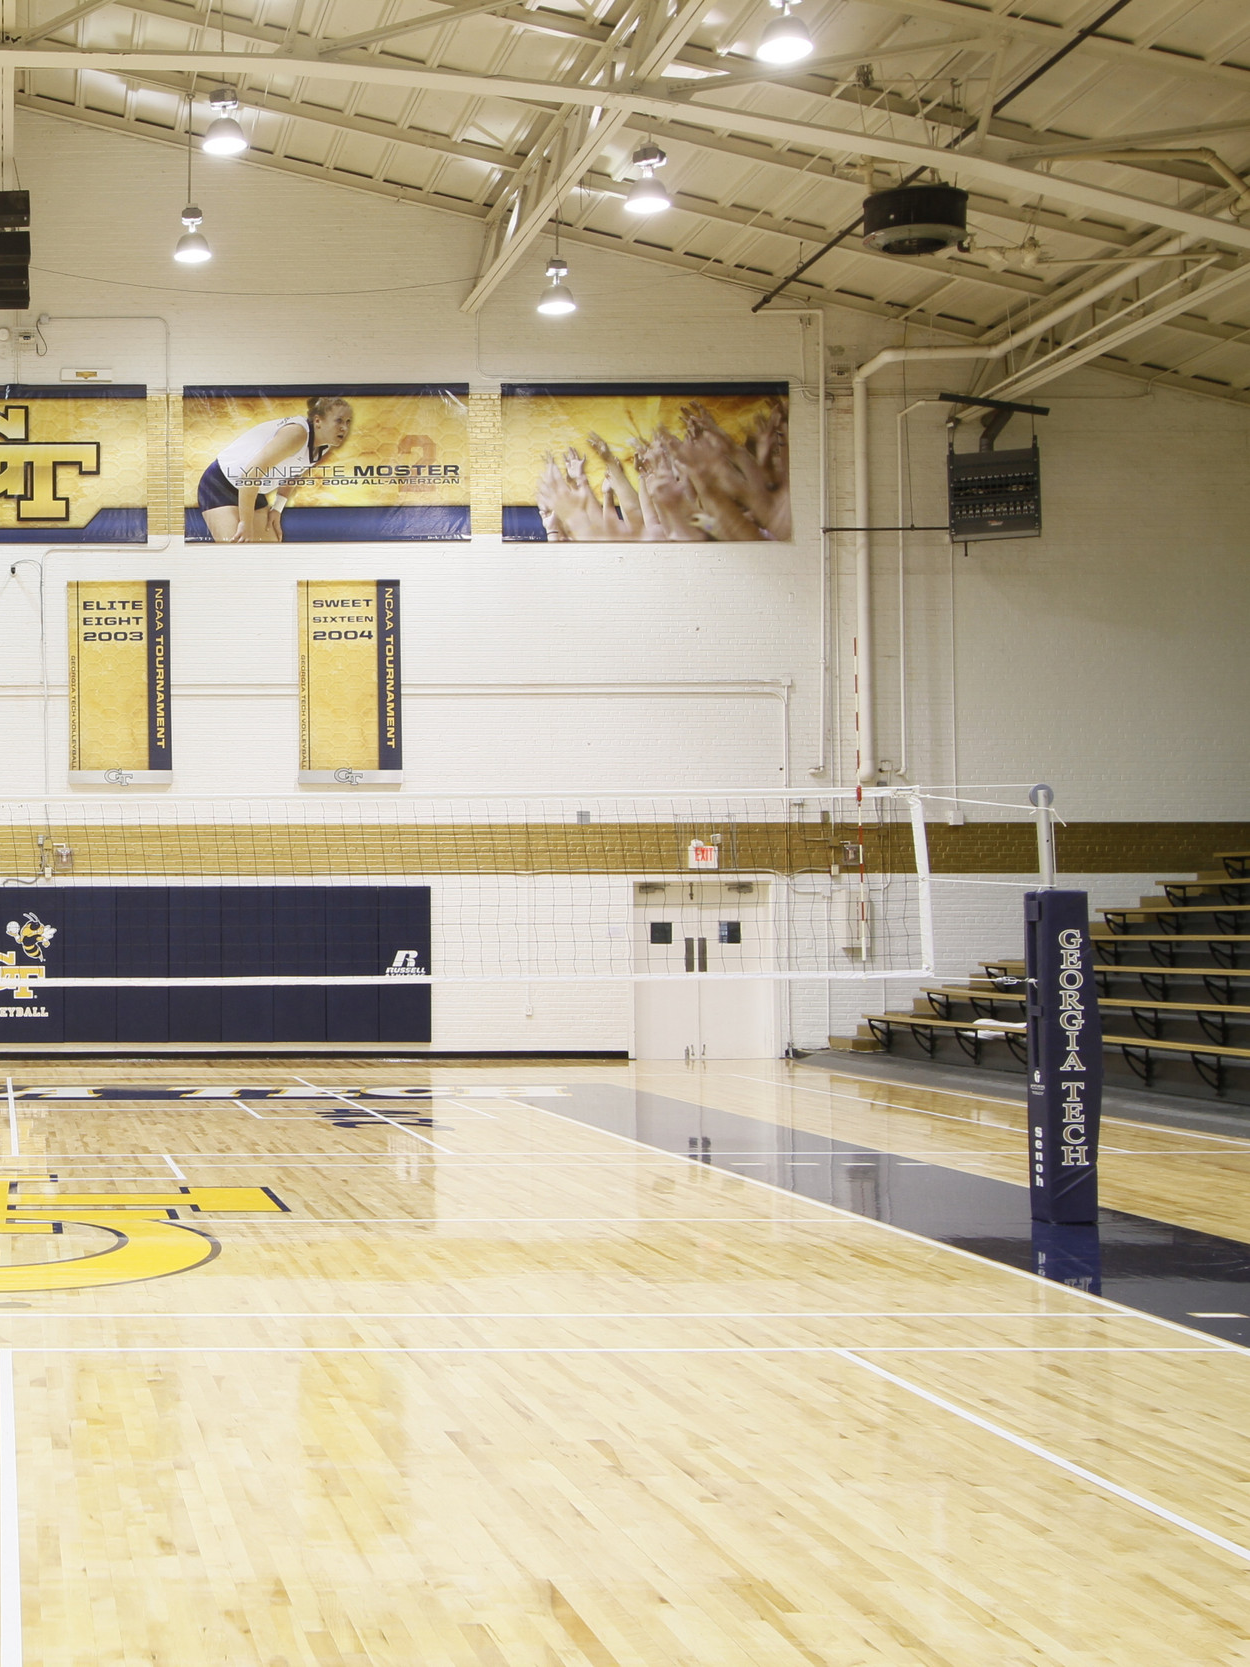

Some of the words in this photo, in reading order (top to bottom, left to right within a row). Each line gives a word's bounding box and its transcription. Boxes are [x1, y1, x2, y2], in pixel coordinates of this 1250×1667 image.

[227, 465, 345, 478] LYNNETTE
[353, 464, 460, 476] MOSTER
[235, 479, 272, 487] 2002
[322, 478, 358, 486] 2004
[361, 477, 460, 485] ALL-AMERICAN
[83, 600, 143, 610] ELITE
[154, 588, 164, 631] NCAA
[312, 599, 373, 608] SWEET
[384, 587, 394, 631] NCAA
[83, 617, 144, 626] EIGHT
[83, 632, 144, 641] 2003
[312, 630, 374, 640] 2004
[155, 635, 165, 749] TOURNAMENT
[385, 634, 395, 749] TOURNAMENT
[695, 847, 714, 862] EXIT
[1058, 928, 1087, 1071] GEORGIA
[166, 1086, 572, 1099] TECH
[1060, 1081, 1090, 1166] TECH
[1034, 1126, 1045, 1188] senoh
